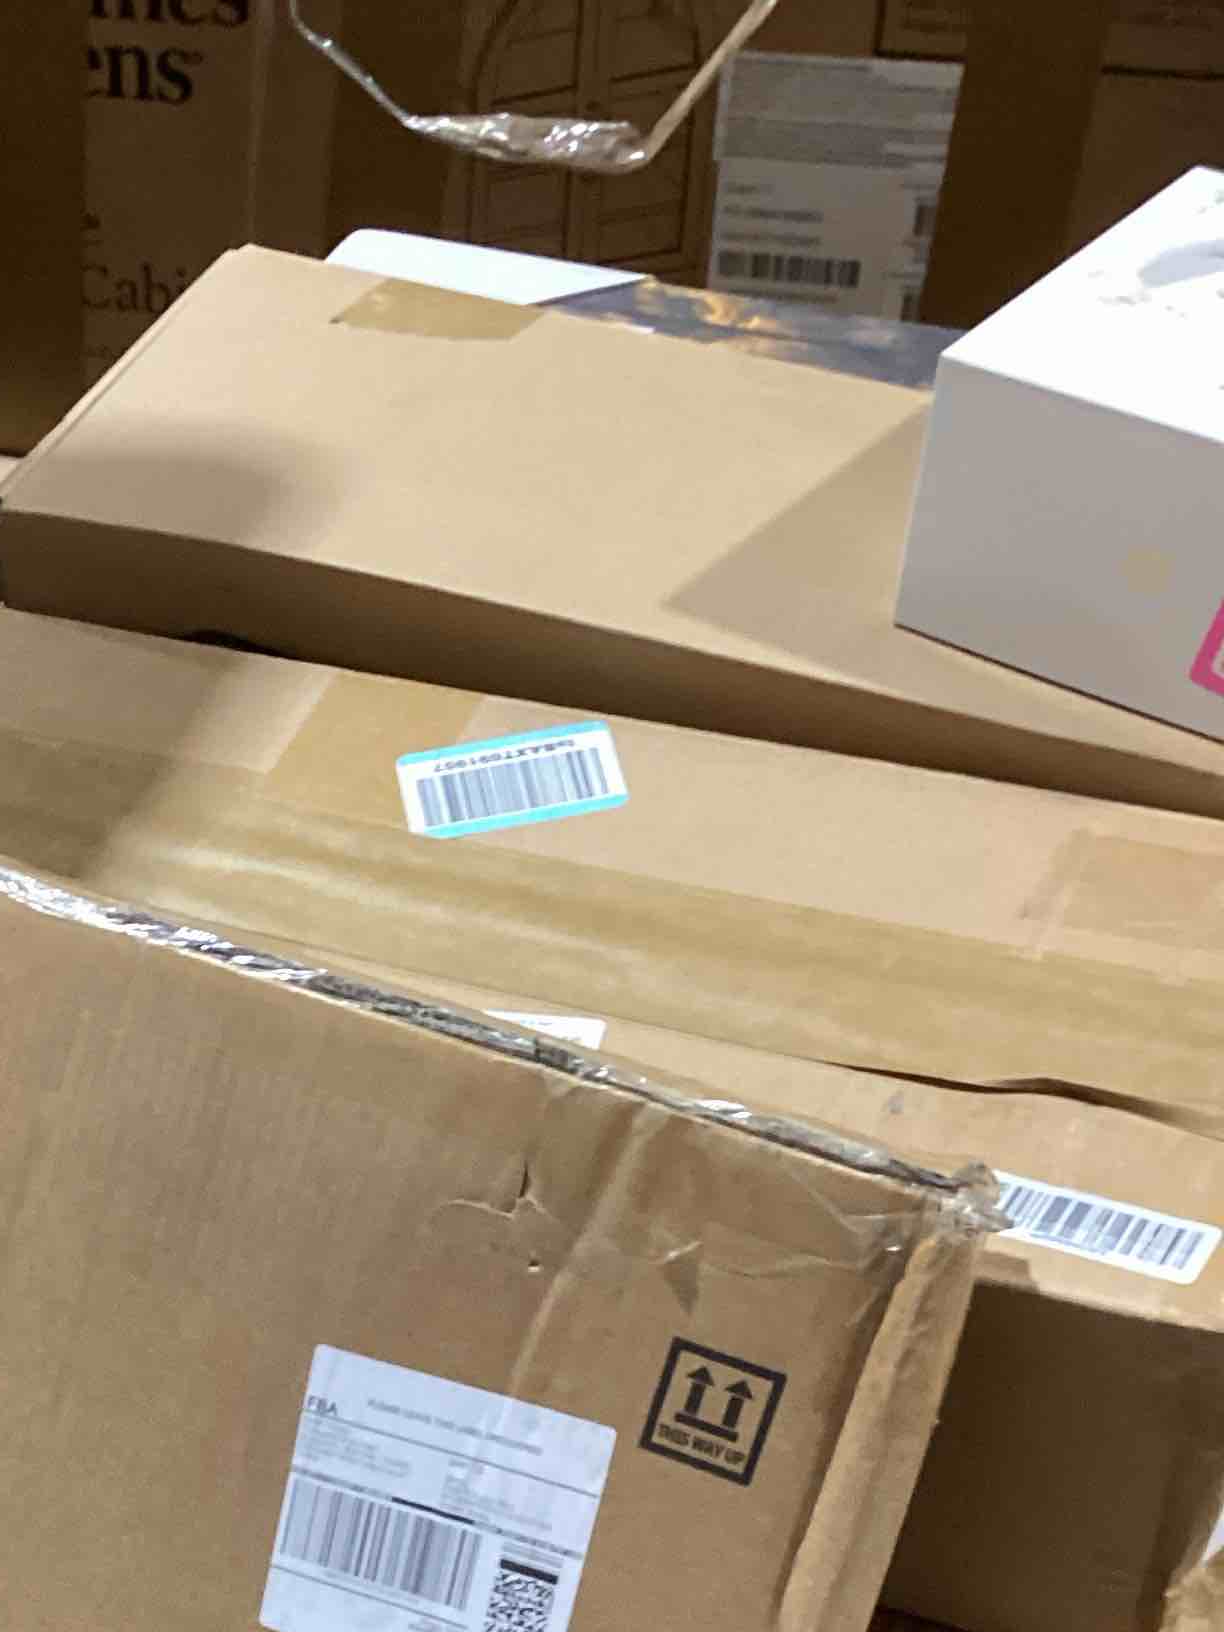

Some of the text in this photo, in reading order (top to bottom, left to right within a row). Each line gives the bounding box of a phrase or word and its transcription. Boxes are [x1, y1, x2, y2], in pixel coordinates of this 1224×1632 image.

[307, 1394, 339, 1417] FBA
[657, 1423, 748, 1466] THIS WAY UP
